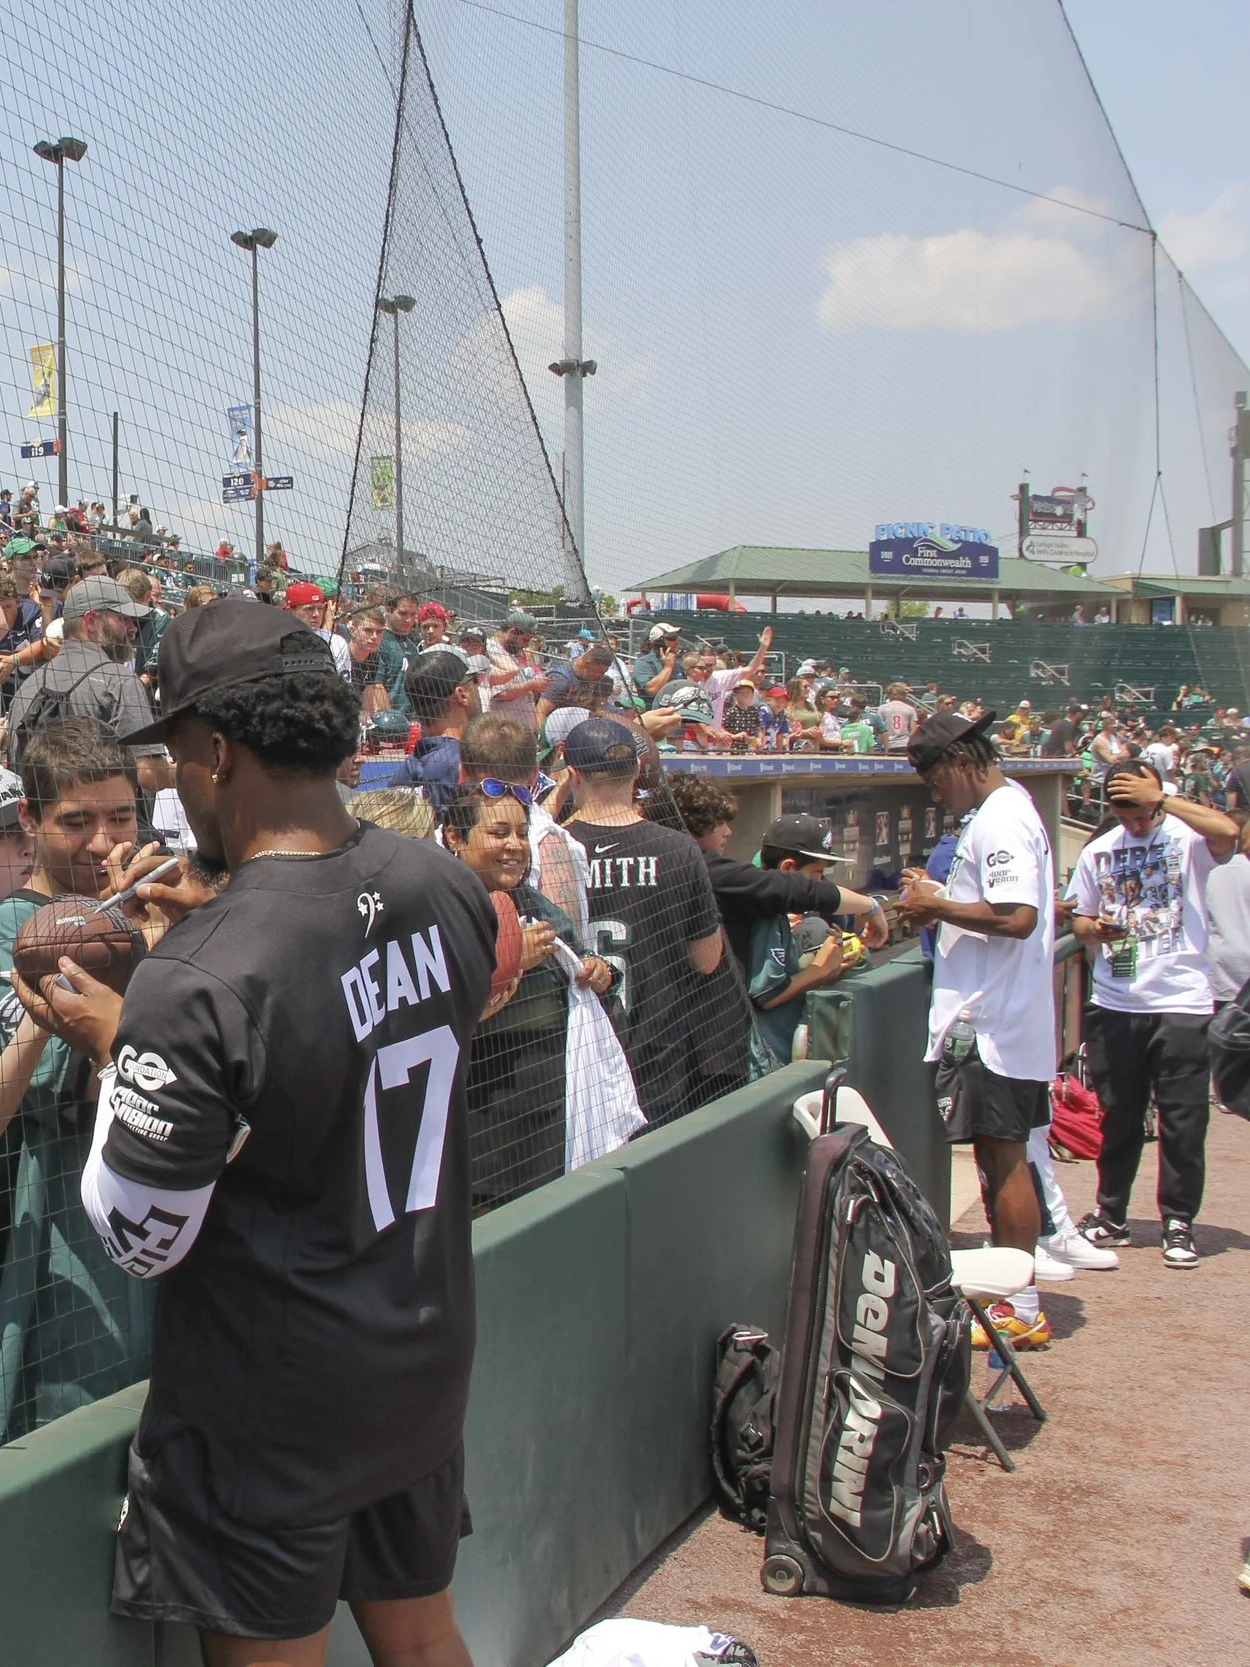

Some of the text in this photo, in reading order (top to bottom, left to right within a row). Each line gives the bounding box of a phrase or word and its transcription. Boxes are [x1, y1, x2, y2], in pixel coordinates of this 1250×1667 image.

[31, 446, 44, 456] 119
[230, 478, 244, 486] 120
[875, 522, 991, 544] PICNIC PATIO
[902, 554, 972, 568] Commonwealth
[917, 547, 938, 558] First
[586, 857, 658, 889] MITH
[341, 924, 451, 1043] DEAN
[126, 1060, 168, 1080] FOUNDATION
[363, 1024, 460, 1233] 17
